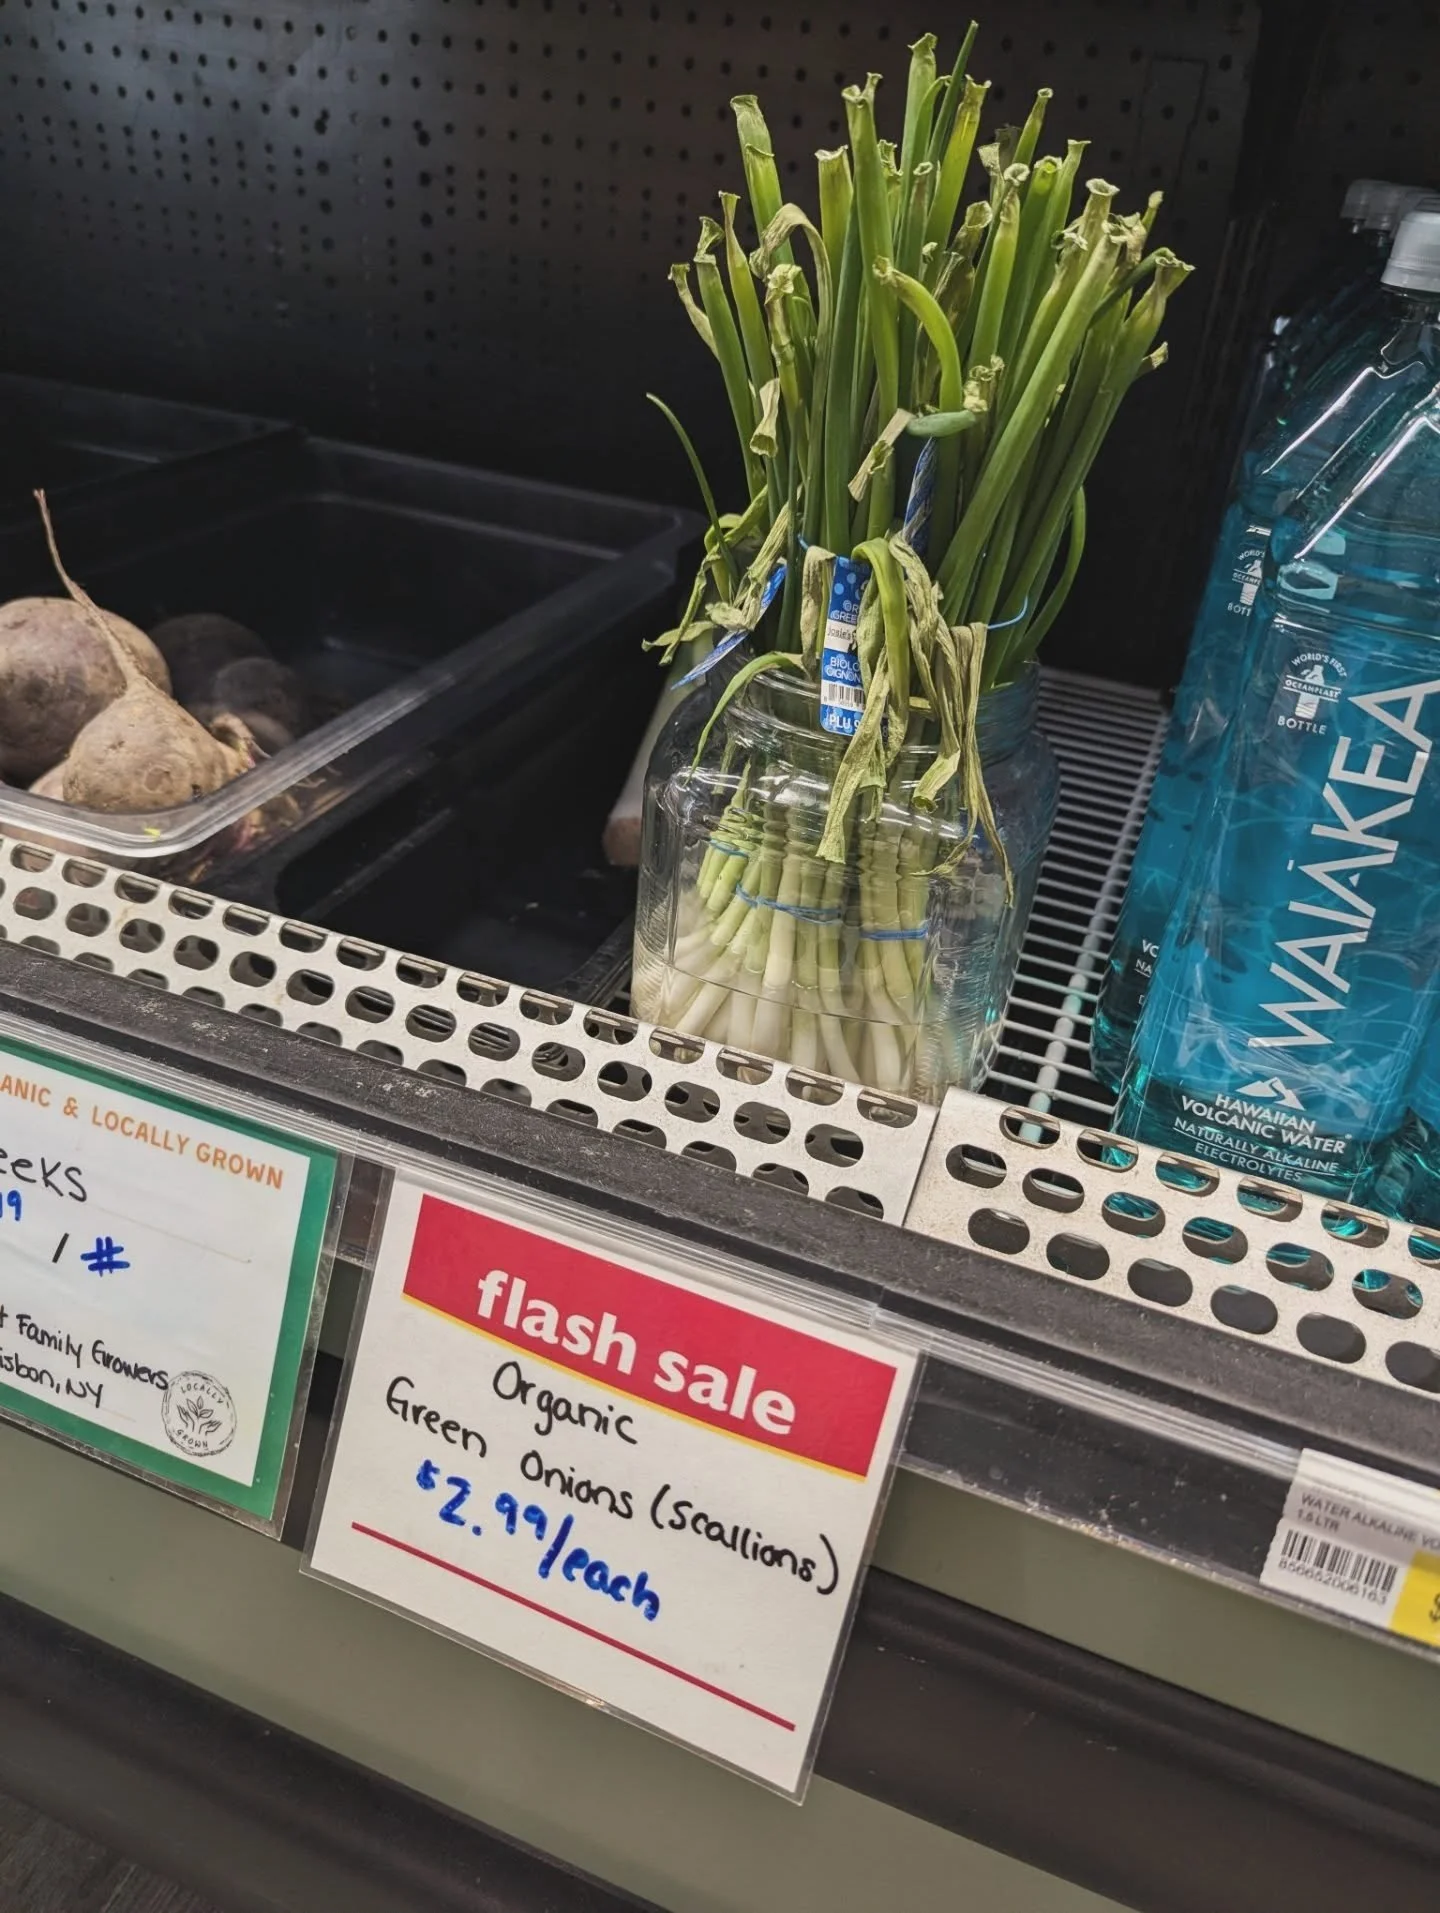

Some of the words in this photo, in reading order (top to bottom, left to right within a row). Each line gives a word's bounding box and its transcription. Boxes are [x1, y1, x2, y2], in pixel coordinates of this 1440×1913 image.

[1291, 652, 1330, 667] WORLD'S
[1329, 658, 1348, 678] FIRST
[829, 713, 851, 730] PLU
[1277, 715, 1328, 735] BOTTLE
[1181, 1095, 1273, 1140] VOLCANIC
[1214, 1093, 1316, 1133] HAWAIIAN
[63, 1096, 79, 1119] &
[92, 1105, 190, 1155] LOCALLY
[196, 1142, 283, 1191] GROWN
[1174, 1117, 1260, 1155] NATURALLY
[1263, 1149, 1339, 1175] ALKALINE
[1195, 1142, 1303, 1183] ELECTROLYTES
[16, 1313, 82, 1368] Family
[92, 1339, 169, 1390] Growers
[476, 1269, 637, 1375] flash
[653, 1351, 796, 1435] sale
[181, 1383, 224, 1404] LOCALLY
[492, 1361, 638, 1445] Organic
[177, 1429, 209, 1448] GROWN
[386, 1377, 487, 1458] Green
[521, 1450, 633, 1519] Onions
[1302, 1492, 1351, 1520] WATER
[1352, 1511, 1418, 1544] ALKALINE
[1315, 1513, 1340, 1533] LTR
